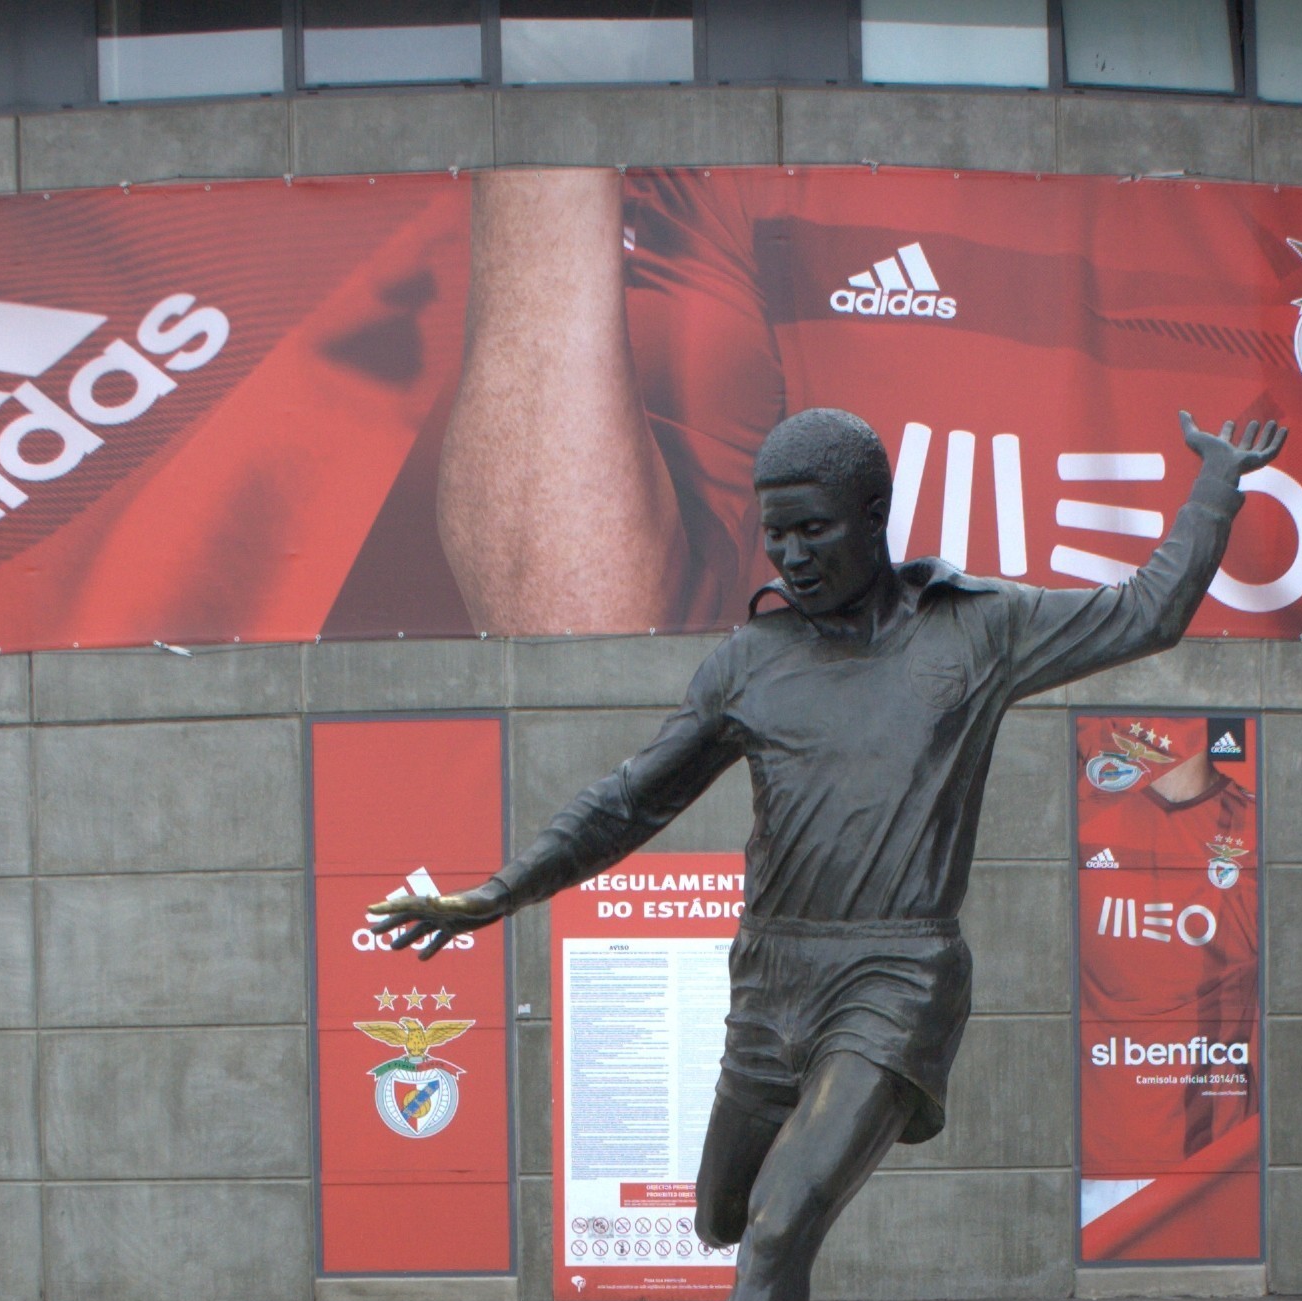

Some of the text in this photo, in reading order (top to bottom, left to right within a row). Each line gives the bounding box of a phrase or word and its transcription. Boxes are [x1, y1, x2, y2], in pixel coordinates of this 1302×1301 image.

[829, 287, 958, 319] adidas
[580, 873, 746, 892] REGULAMENT
[597, 900, 633, 919] DO
[1097, 895, 1218, 947] MEO
[1091, 1036, 1249, 1066] sl benfica
[1135, 1074, 1178, 1085] Camisola
[1179, 1073, 1208, 1085] oficial
